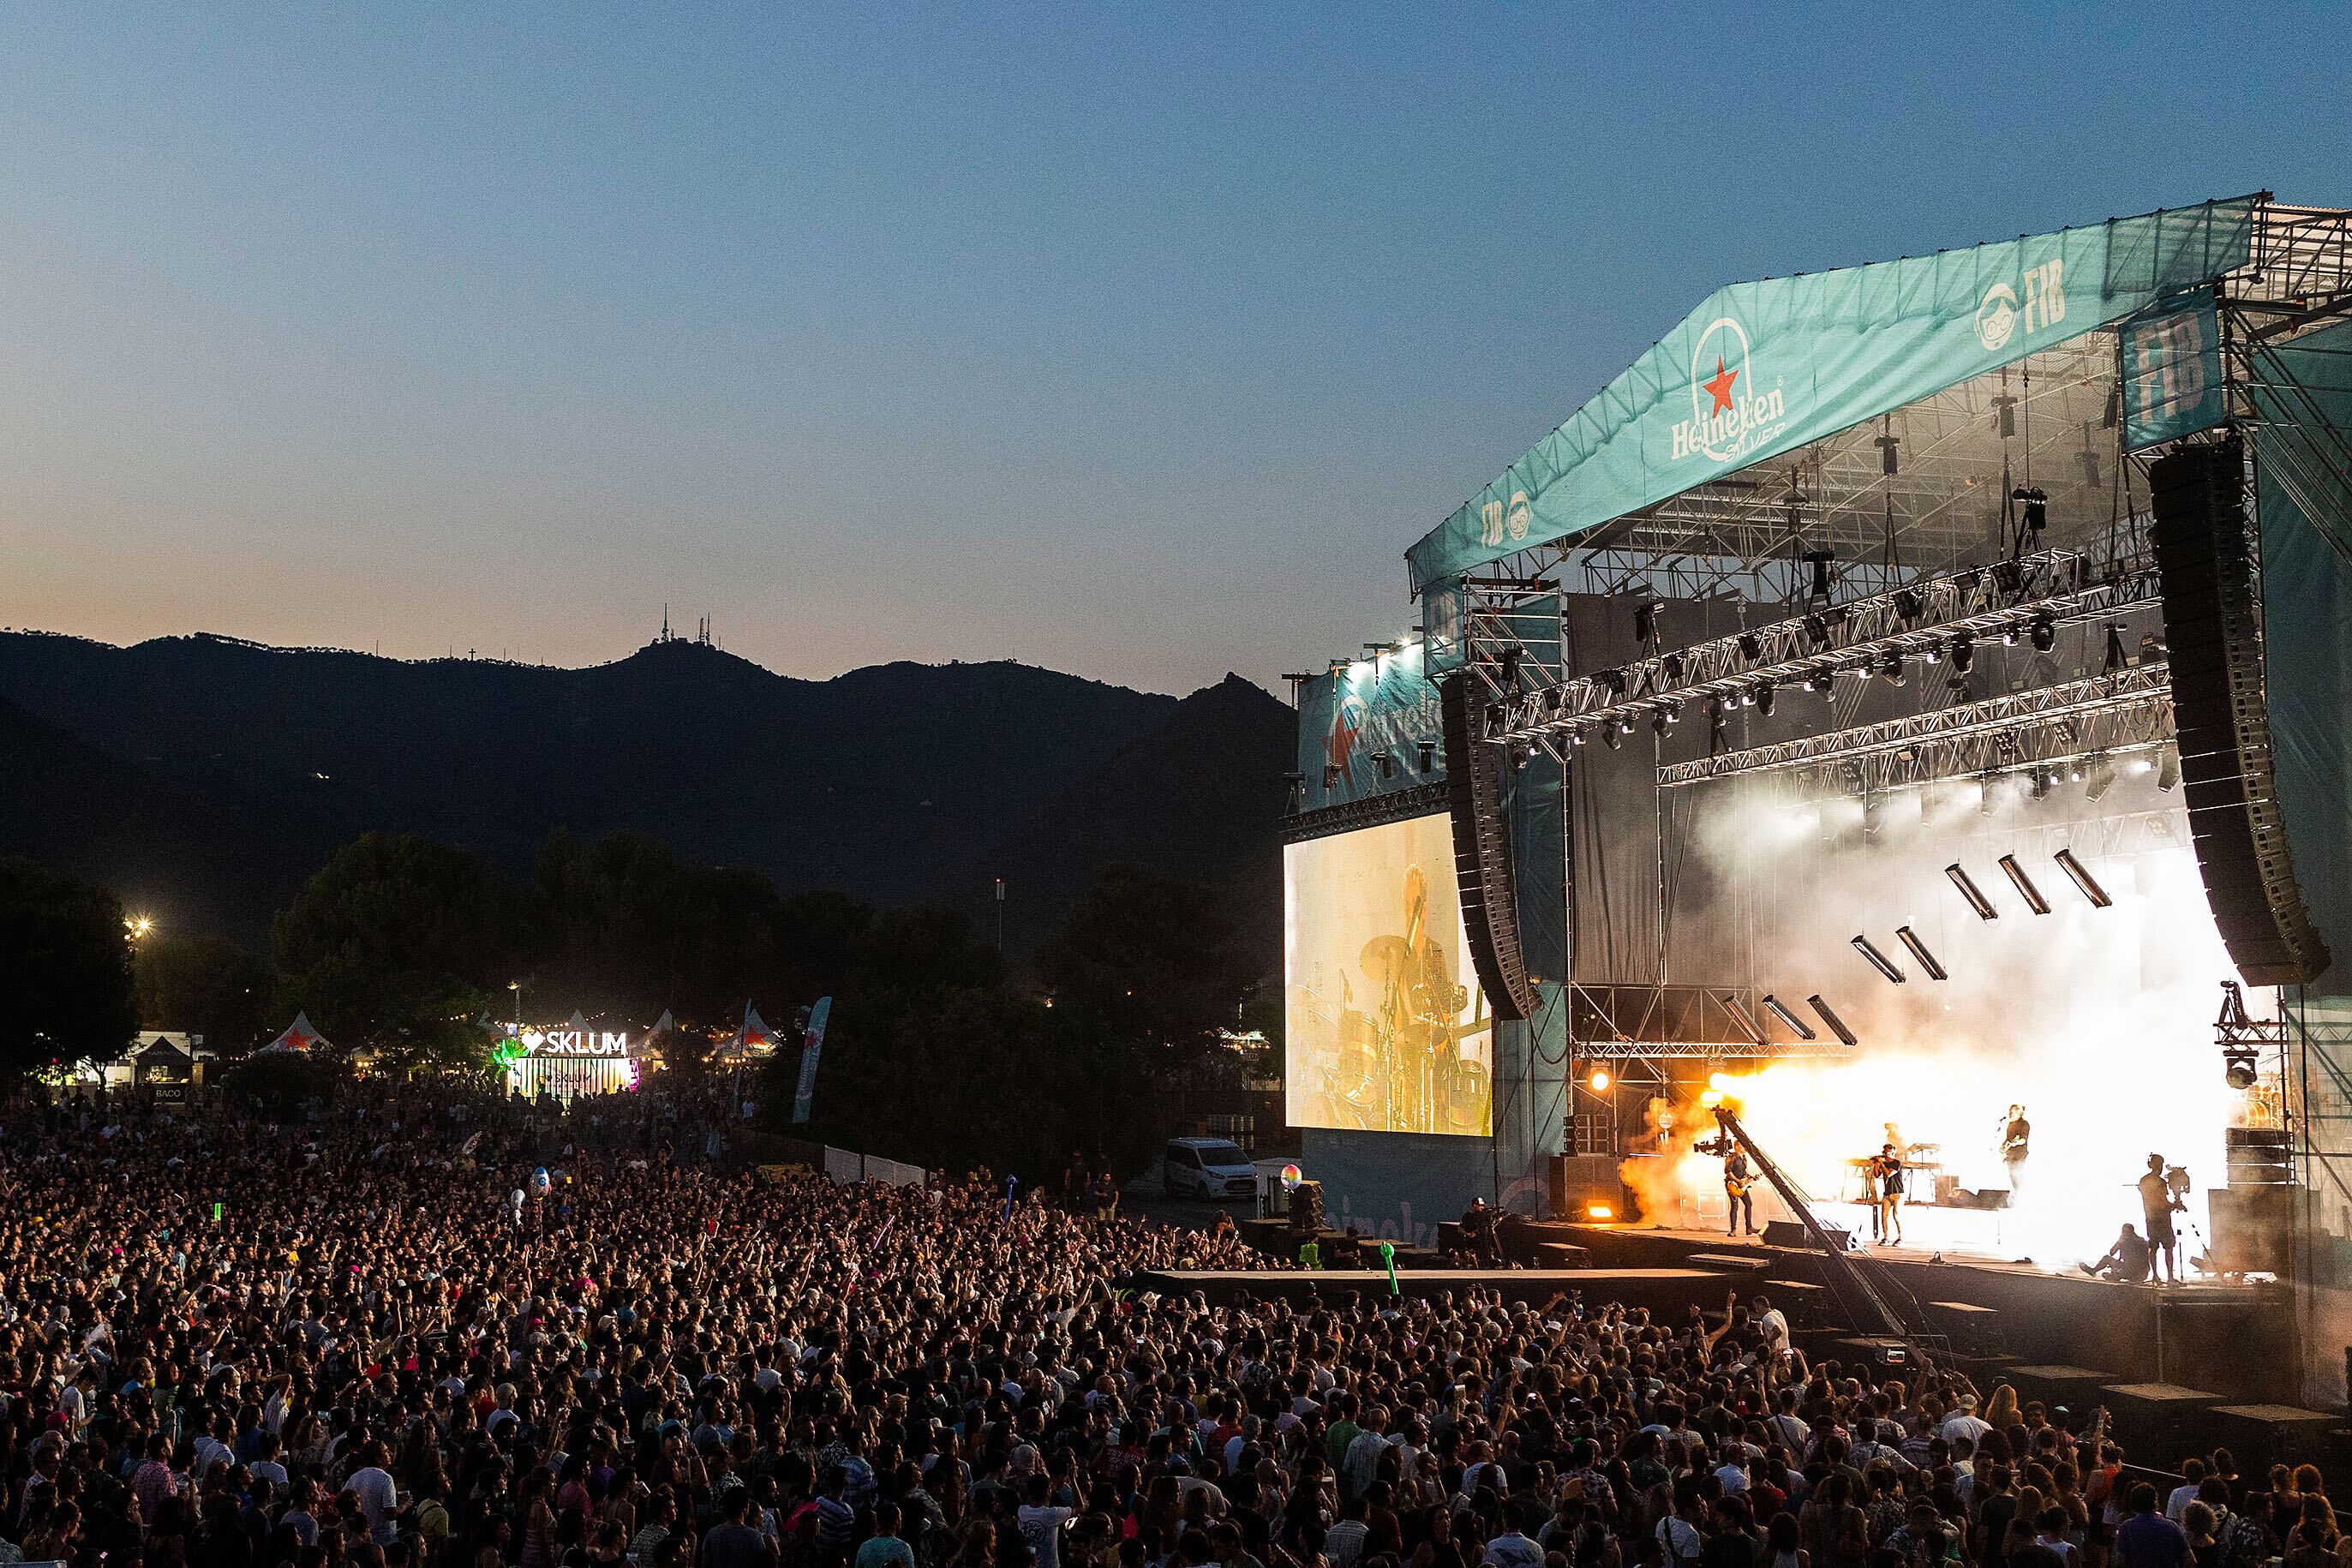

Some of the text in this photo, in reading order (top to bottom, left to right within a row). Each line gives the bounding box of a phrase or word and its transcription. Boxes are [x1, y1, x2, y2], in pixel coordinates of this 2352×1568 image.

[2023, 258, 2065, 335] FIB
[2135, 311, 2205, 426] FIB
[1671, 388, 1786, 461] Heineken
[1724, 422, 1786, 464] SILVER
[1481, 500, 1504, 549] FIB
[546, 1031, 627, 1056] SKLUM
